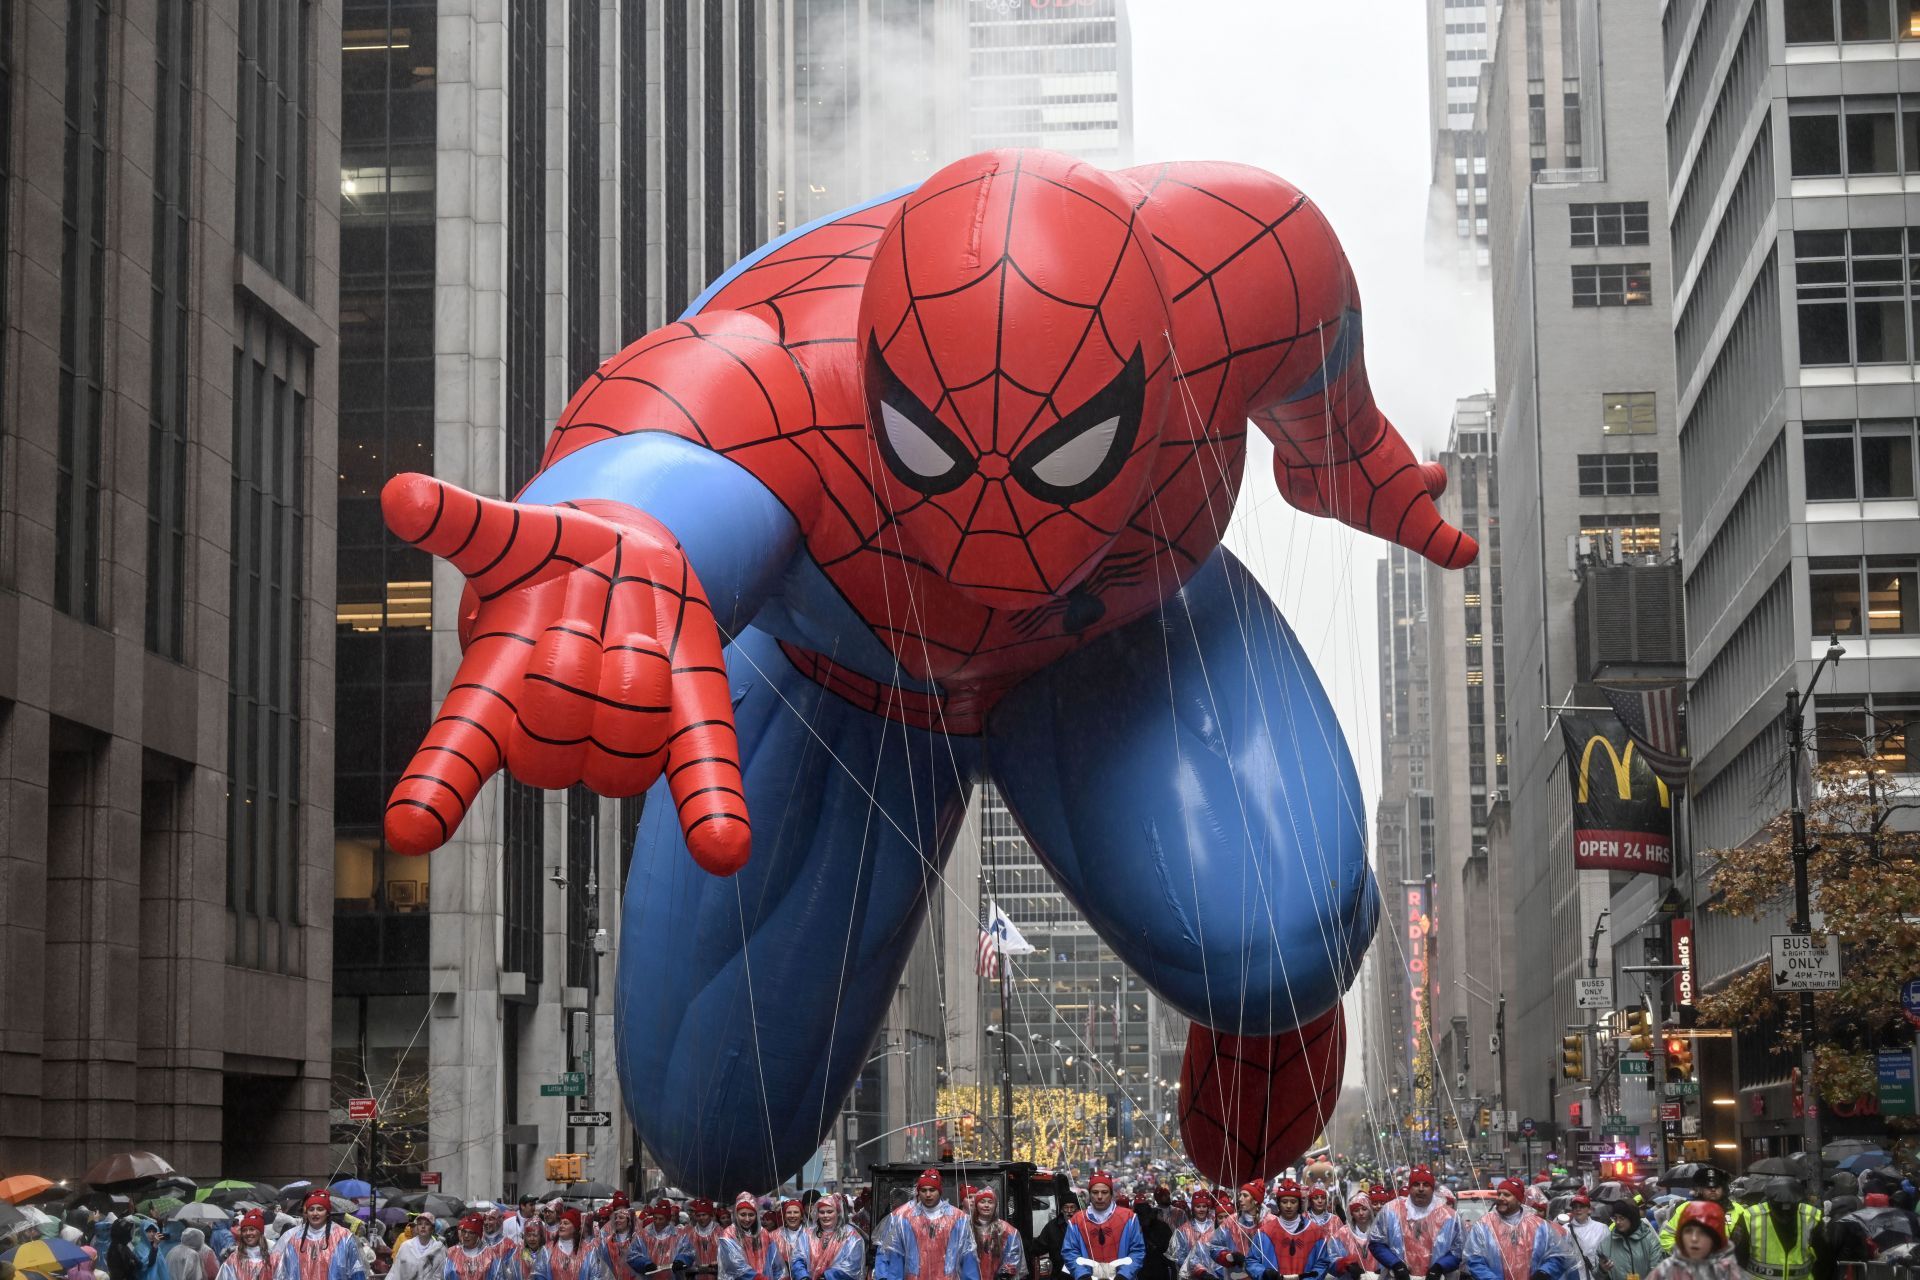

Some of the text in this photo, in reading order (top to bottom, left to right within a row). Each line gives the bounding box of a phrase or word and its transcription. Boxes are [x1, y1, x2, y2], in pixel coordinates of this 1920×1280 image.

[1580, 840, 1670, 863] OPEN 24 HRS
[1408, 892, 1424, 973] RADIO
[1788, 957, 1823, 969] ONLY
[1795, 971, 1835, 979] 4PM-7PM
[1629, 1062, 1634, 1072] W
[1635, 1062, 1641, 1072] 46
[571, 1073, 579, 1083] 46
[1683, 1085, 1692, 1094] 46
